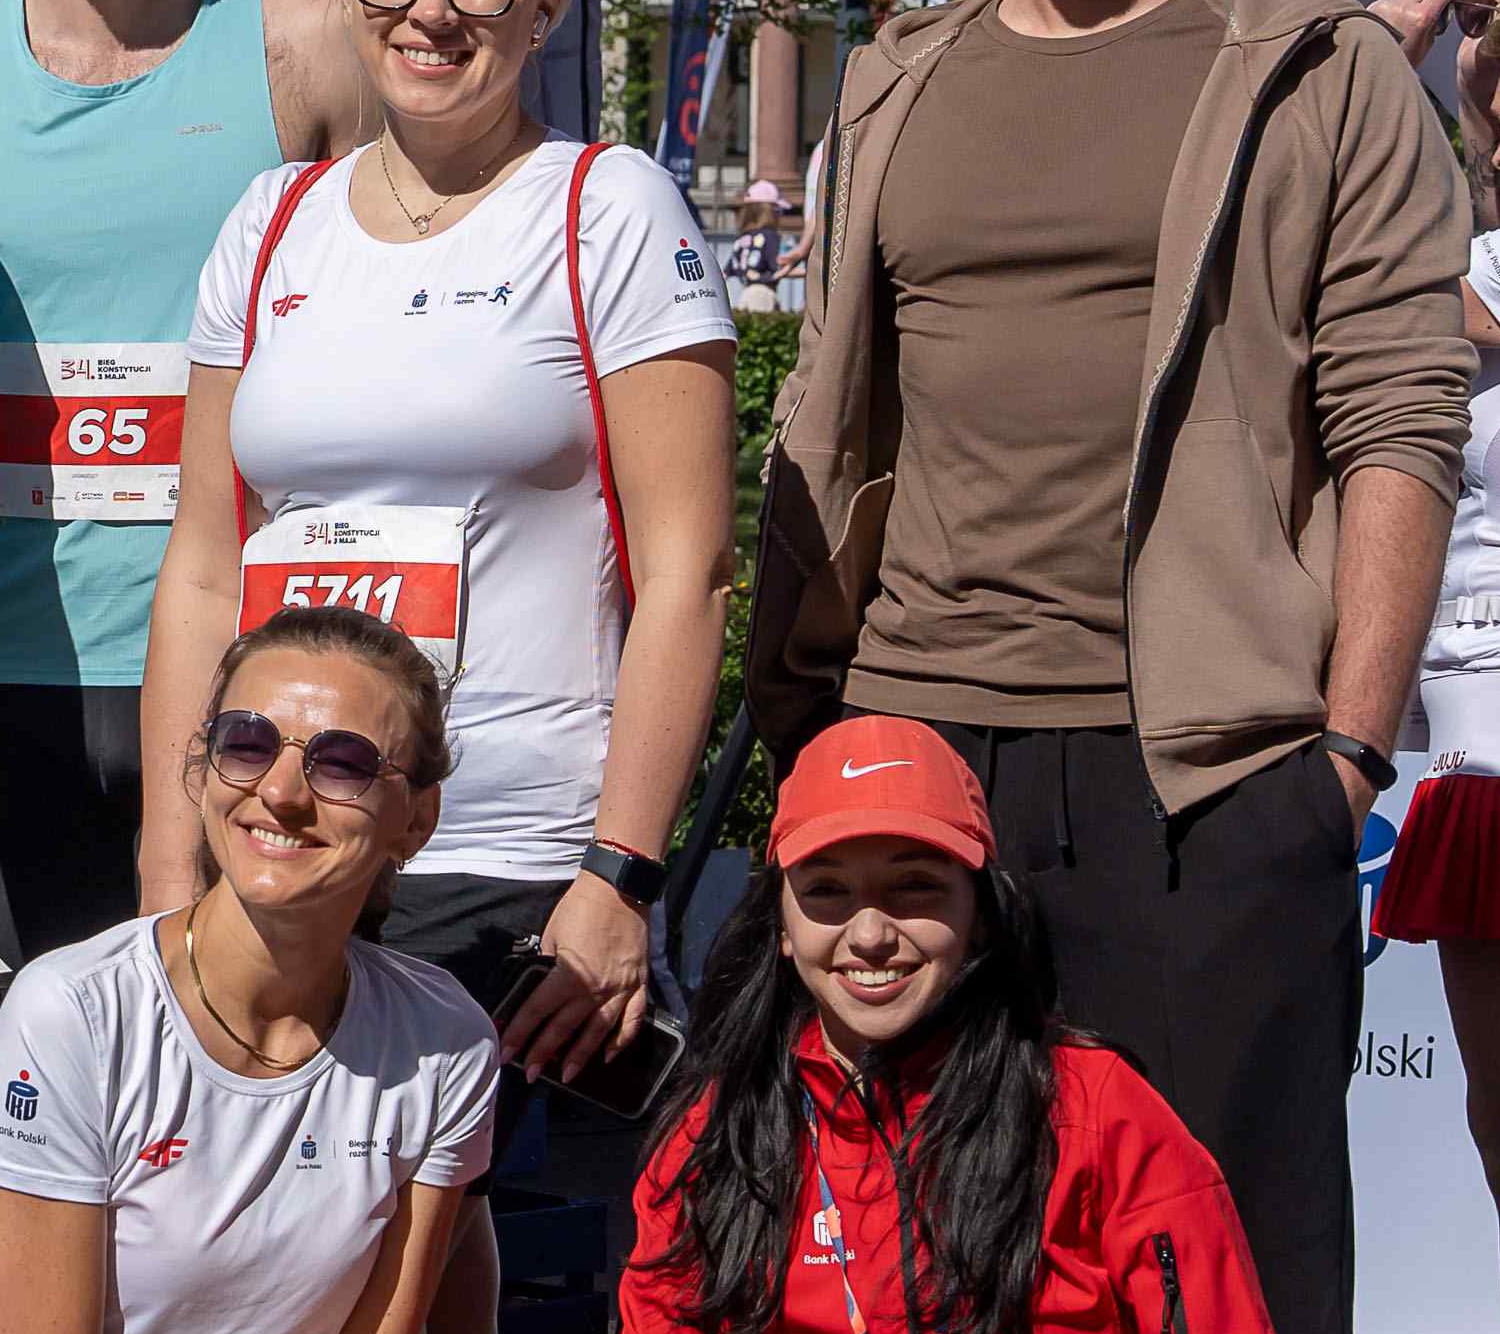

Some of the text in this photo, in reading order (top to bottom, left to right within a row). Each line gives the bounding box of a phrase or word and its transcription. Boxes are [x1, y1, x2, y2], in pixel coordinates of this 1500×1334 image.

[674, 249, 704, 281] PKO
[68, 408, 149, 456] 65
[281, 574, 403, 624] 5711
[5, 1081, 39, 1121] PKO
[17, 1130, 47, 1145] Polski
[138, 1138, 189, 1167] 4F
[804, 1253, 829, 1265] Bank
